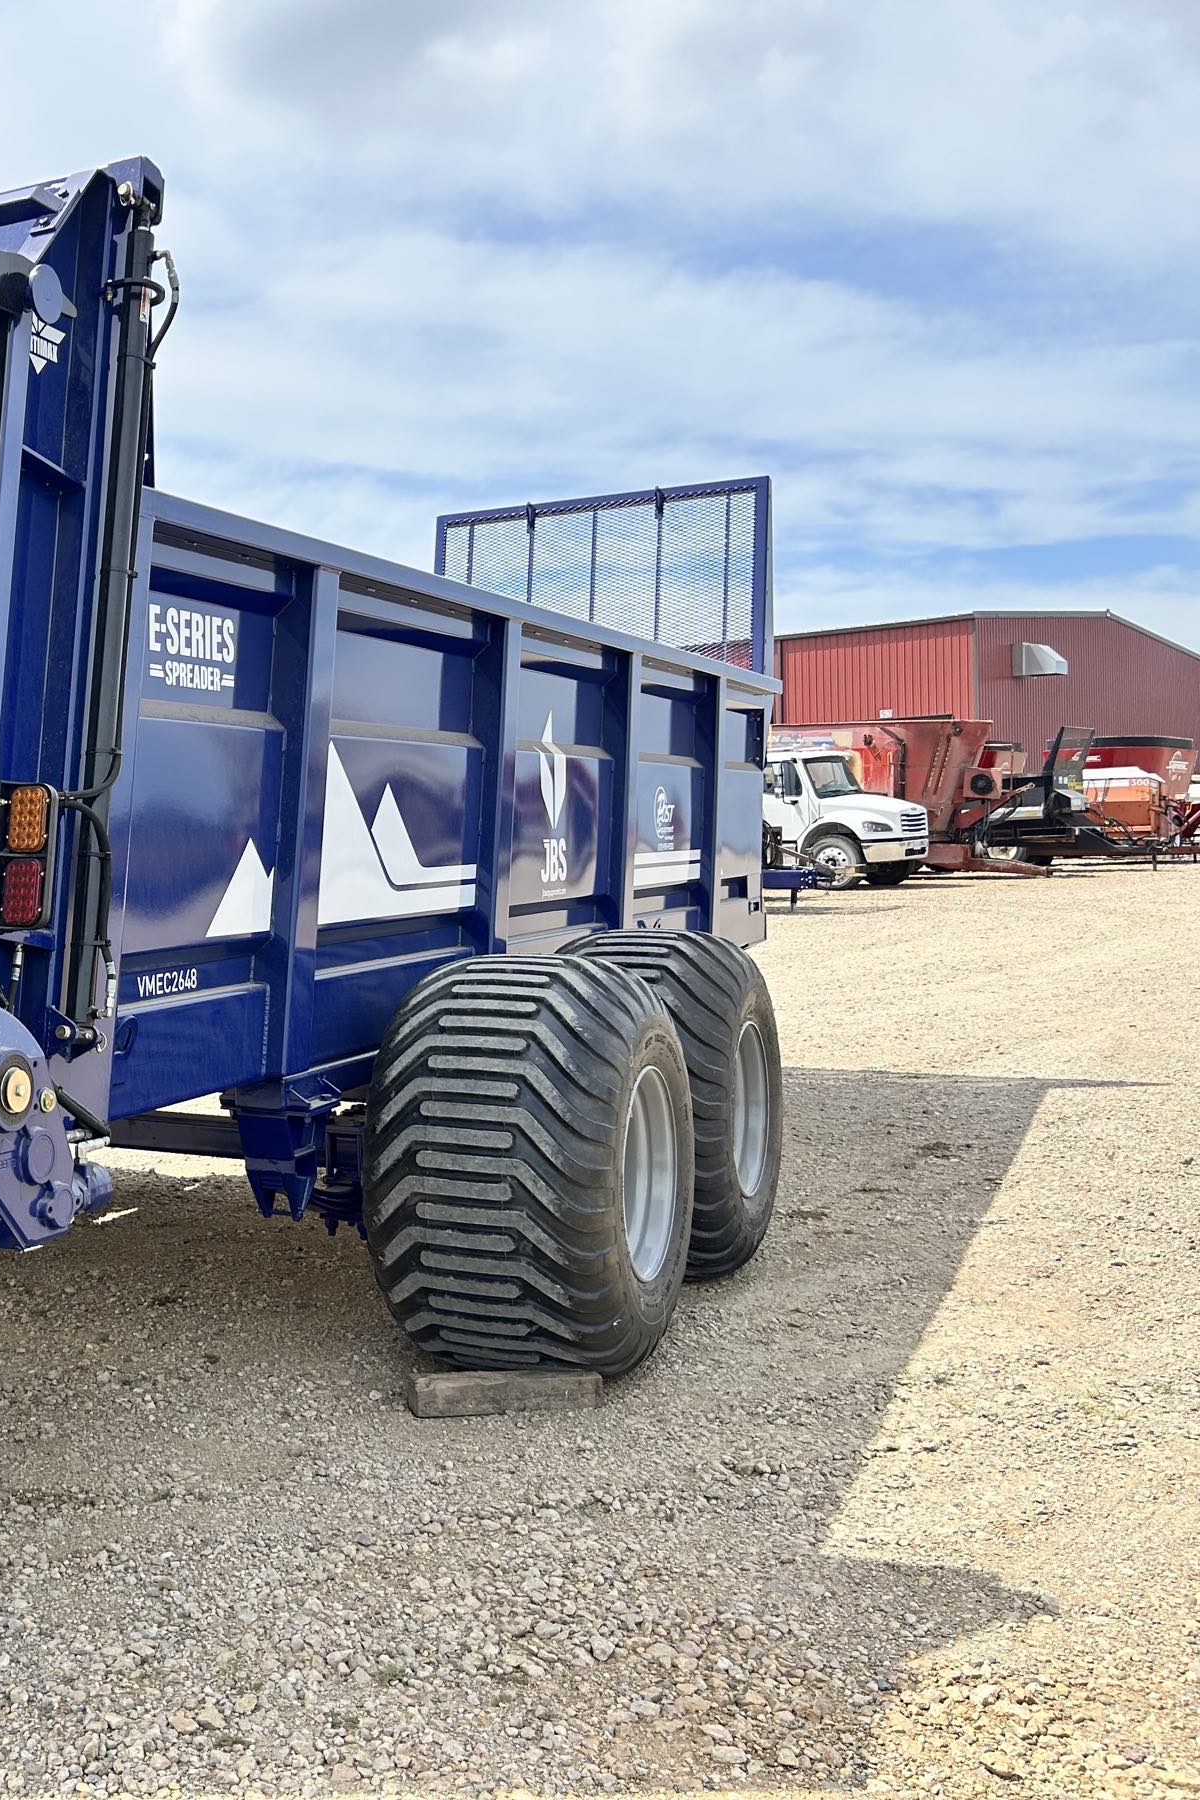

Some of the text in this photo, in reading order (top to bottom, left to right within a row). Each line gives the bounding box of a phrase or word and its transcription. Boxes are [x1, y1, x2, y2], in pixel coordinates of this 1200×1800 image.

[149, 603, 235, 664] E-SERIES
[164, 660, 221, 692] SPREADER
[541, 838, 567, 883] JBS
[137, 968, 198, 998] VMEC2648
